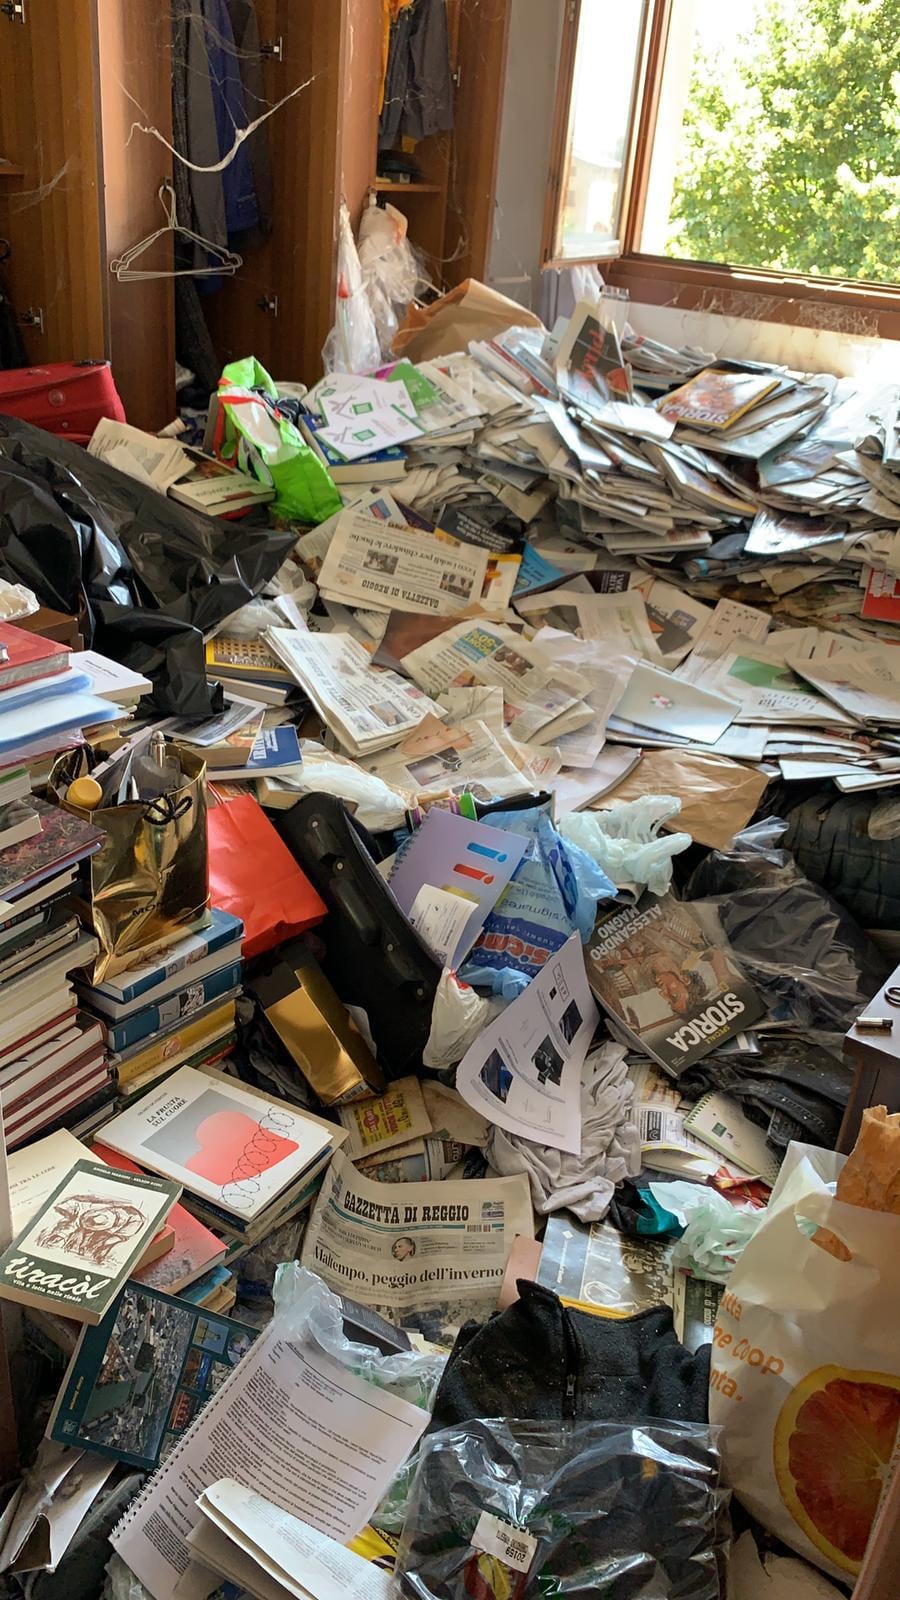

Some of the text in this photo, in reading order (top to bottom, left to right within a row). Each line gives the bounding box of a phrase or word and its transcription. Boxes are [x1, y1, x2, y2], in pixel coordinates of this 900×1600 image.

[361, 579, 440, 609] GAZZETTA DI REGGIO
[590, 903, 663, 961] ALESSANDRO
[597, 904, 641, 939] MAGNO
[666, 992, 745, 1053] STORICA
[146, 1113, 158, 1124] LA
[156, 1096, 181, 1117] FRUSTA
[151, 1116, 166, 1128] SUL
[165, 1098, 188, 1118] CUORE
[343, 1190, 469, 1224] GAZZETTA DI REGGIO
[4, 1256, 111, 1299] tiracòl
[313, 1246, 504, 1289] Maltempo, peggio dell'inverno
[732, 1338, 785, 1376] Coop
[505, 1546, 526, 1563] 20159
